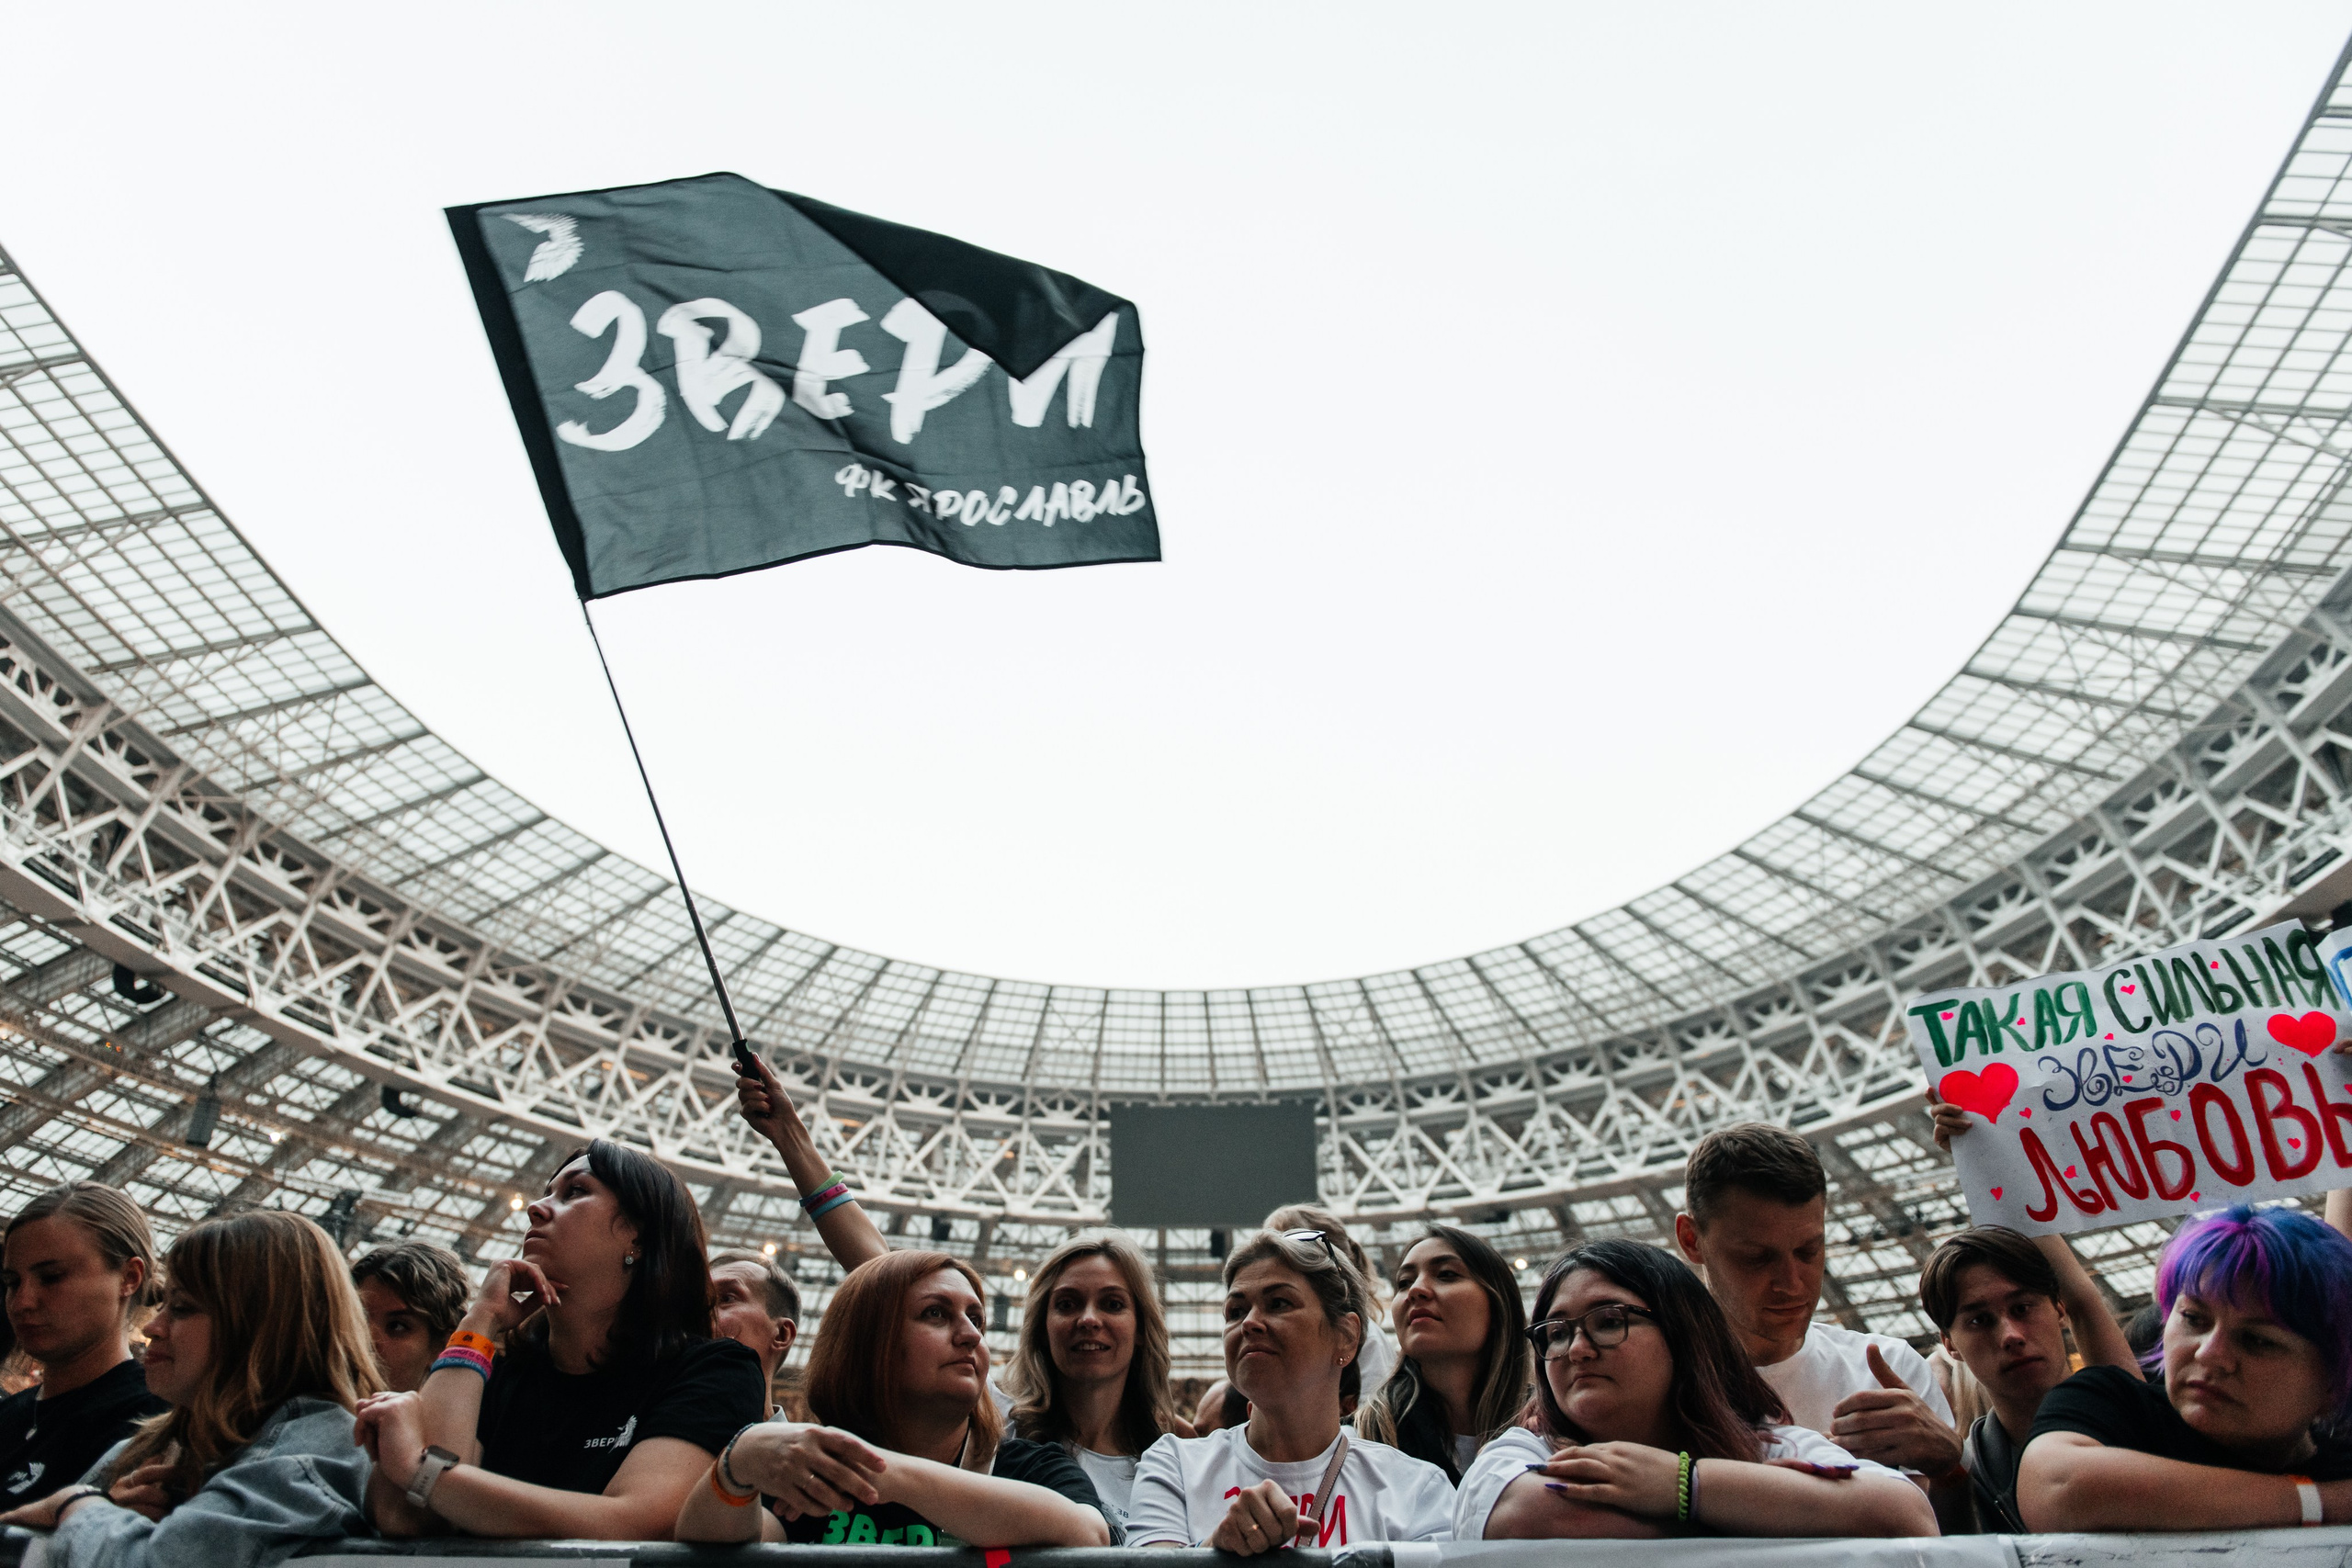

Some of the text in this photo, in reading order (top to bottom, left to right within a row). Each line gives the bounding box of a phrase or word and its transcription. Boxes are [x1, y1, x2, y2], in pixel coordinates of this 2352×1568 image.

[834, 462, 1146, 527] ФК ЯРОСЛАВЛЬ
[1907, 980, 2098, 1067] ТАКАЯ
[2102, 929, 2340, 1033] СИЛЬНАЯ
[2018, 1062, 2352, 1223] ЛЮБОВЬ
[821, 1509, 939, 1547] ЗВЕР
